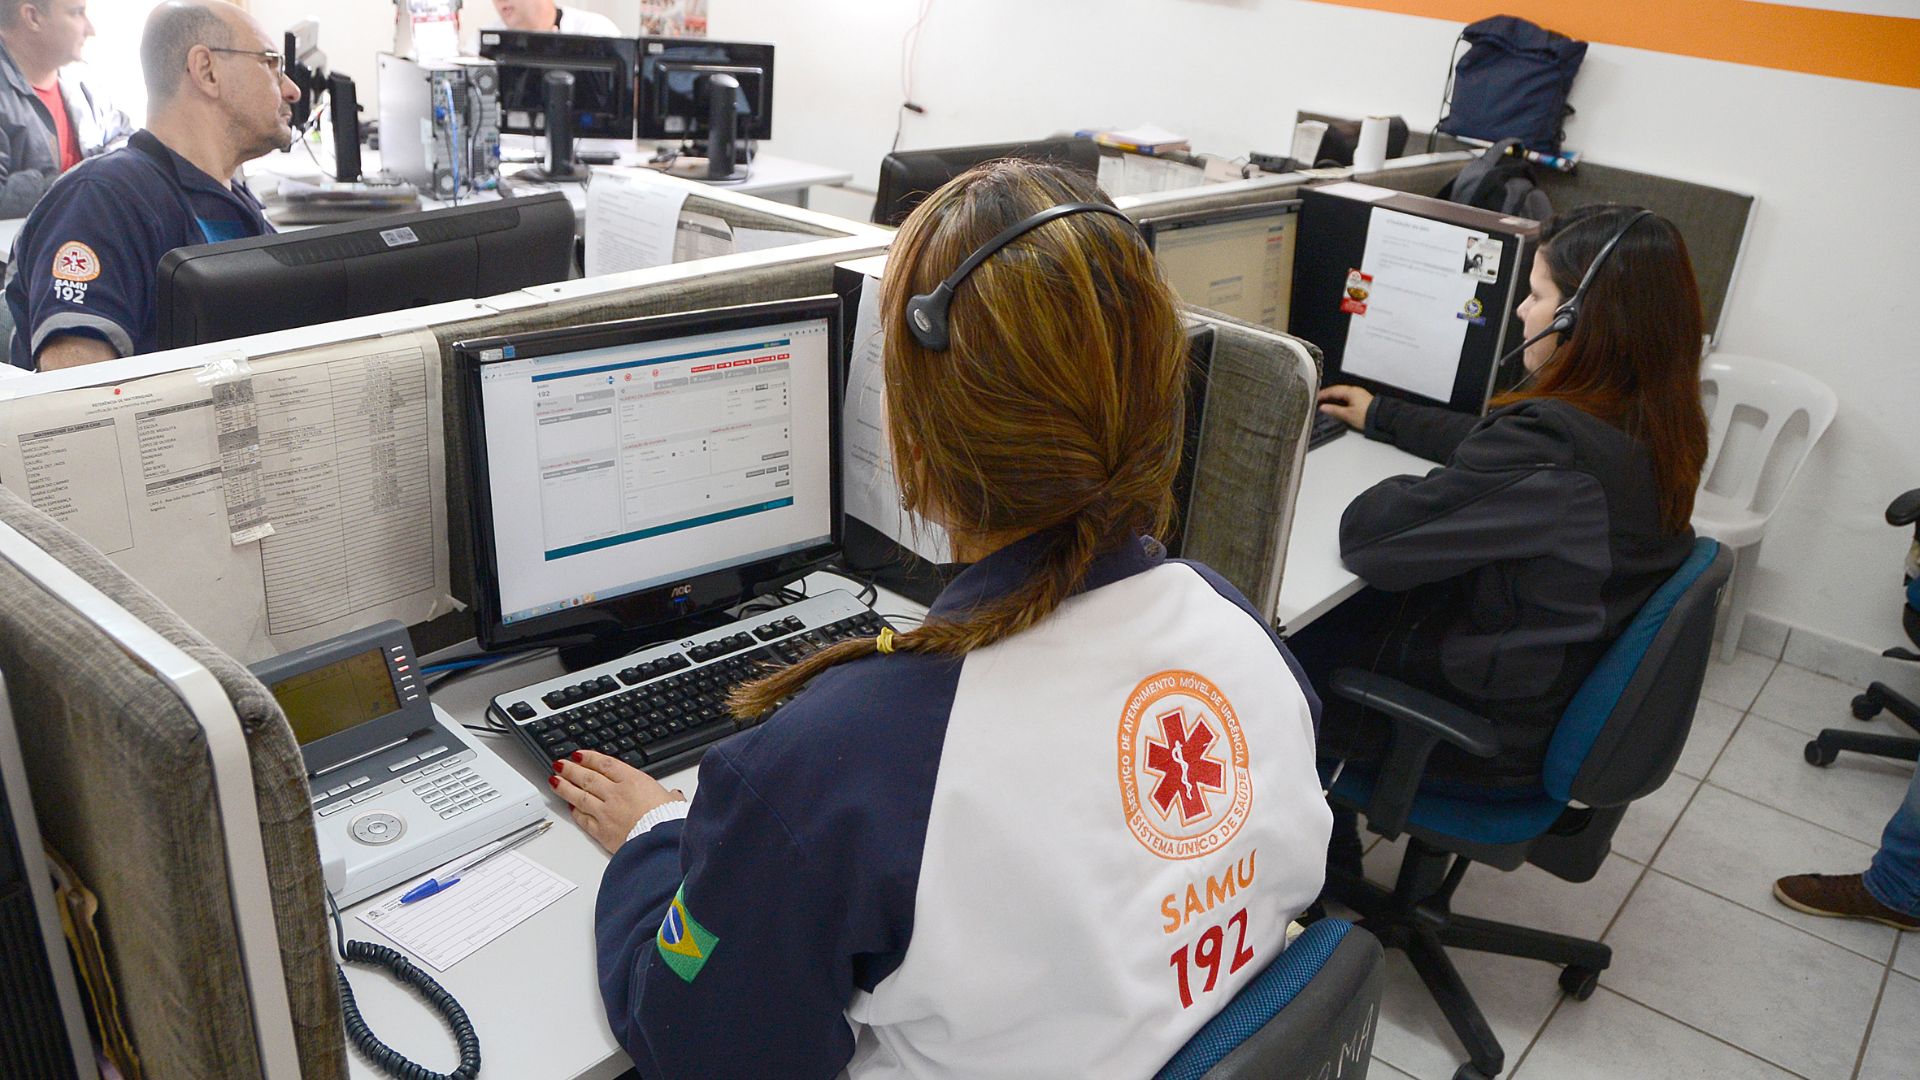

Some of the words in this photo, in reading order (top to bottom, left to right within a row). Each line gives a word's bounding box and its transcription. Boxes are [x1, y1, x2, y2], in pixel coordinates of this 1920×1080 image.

[54, 286, 84, 304] 192
[55, 279, 87, 291] SAMU
[671, 584, 692, 598] AOC
[1180, 674, 1210, 697] MÓVEL
[1124, 676, 1176, 732] ATENDIMENTO
[1208, 690, 1223, 706] DE
[1121, 734, 1130, 751] DE
[1121, 755, 1137, 813] SERVIÇO
[1132, 815, 1174, 854] SISTEMA
[1219, 817, 1237, 837] DE
[1161, 848, 1258, 934] SAMU
[1170, 907, 1254, 1009] 192
